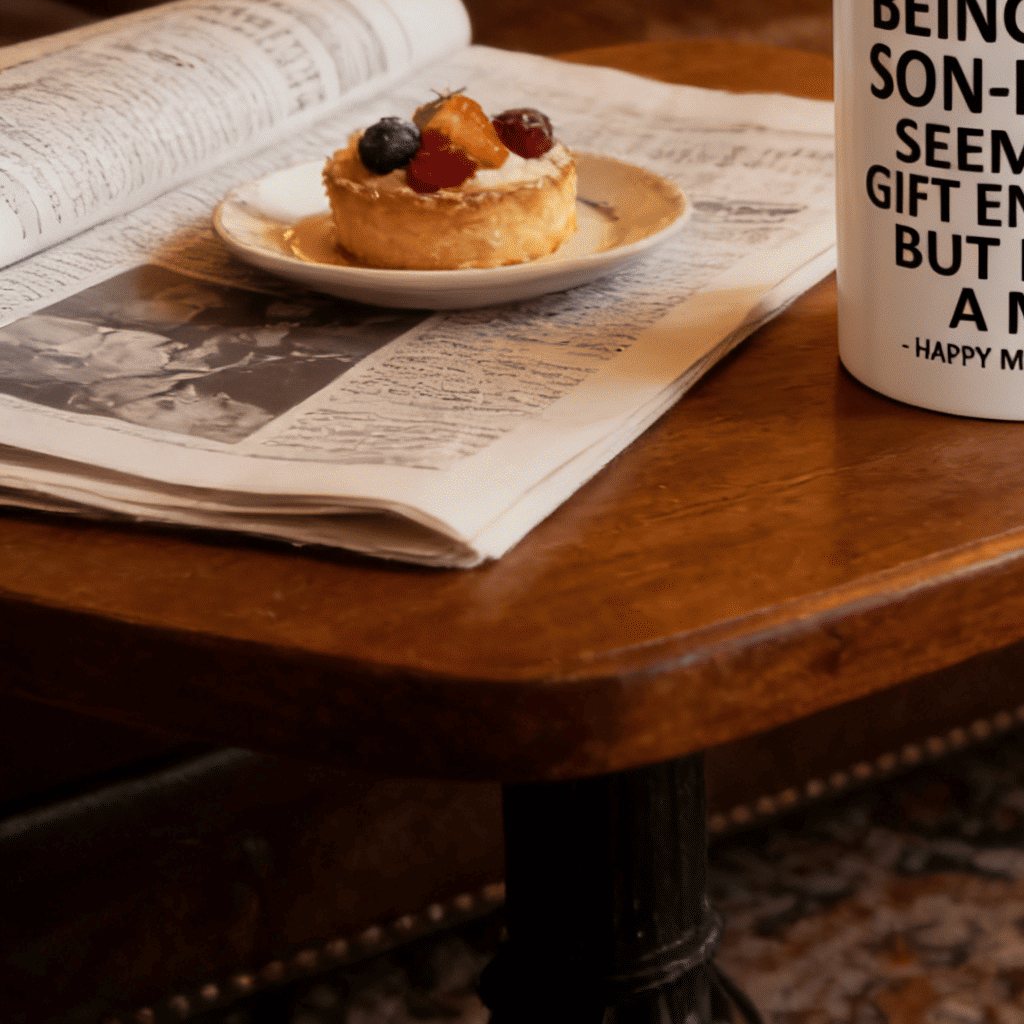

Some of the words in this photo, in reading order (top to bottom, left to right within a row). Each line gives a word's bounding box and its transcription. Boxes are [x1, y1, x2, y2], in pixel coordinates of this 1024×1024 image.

[865, 163, 963, 225] GIFT
[894, 222, 1002, 282] BUT
[948, 286, 990, 334] A
[914, 336, 993, 370] HAPPY
